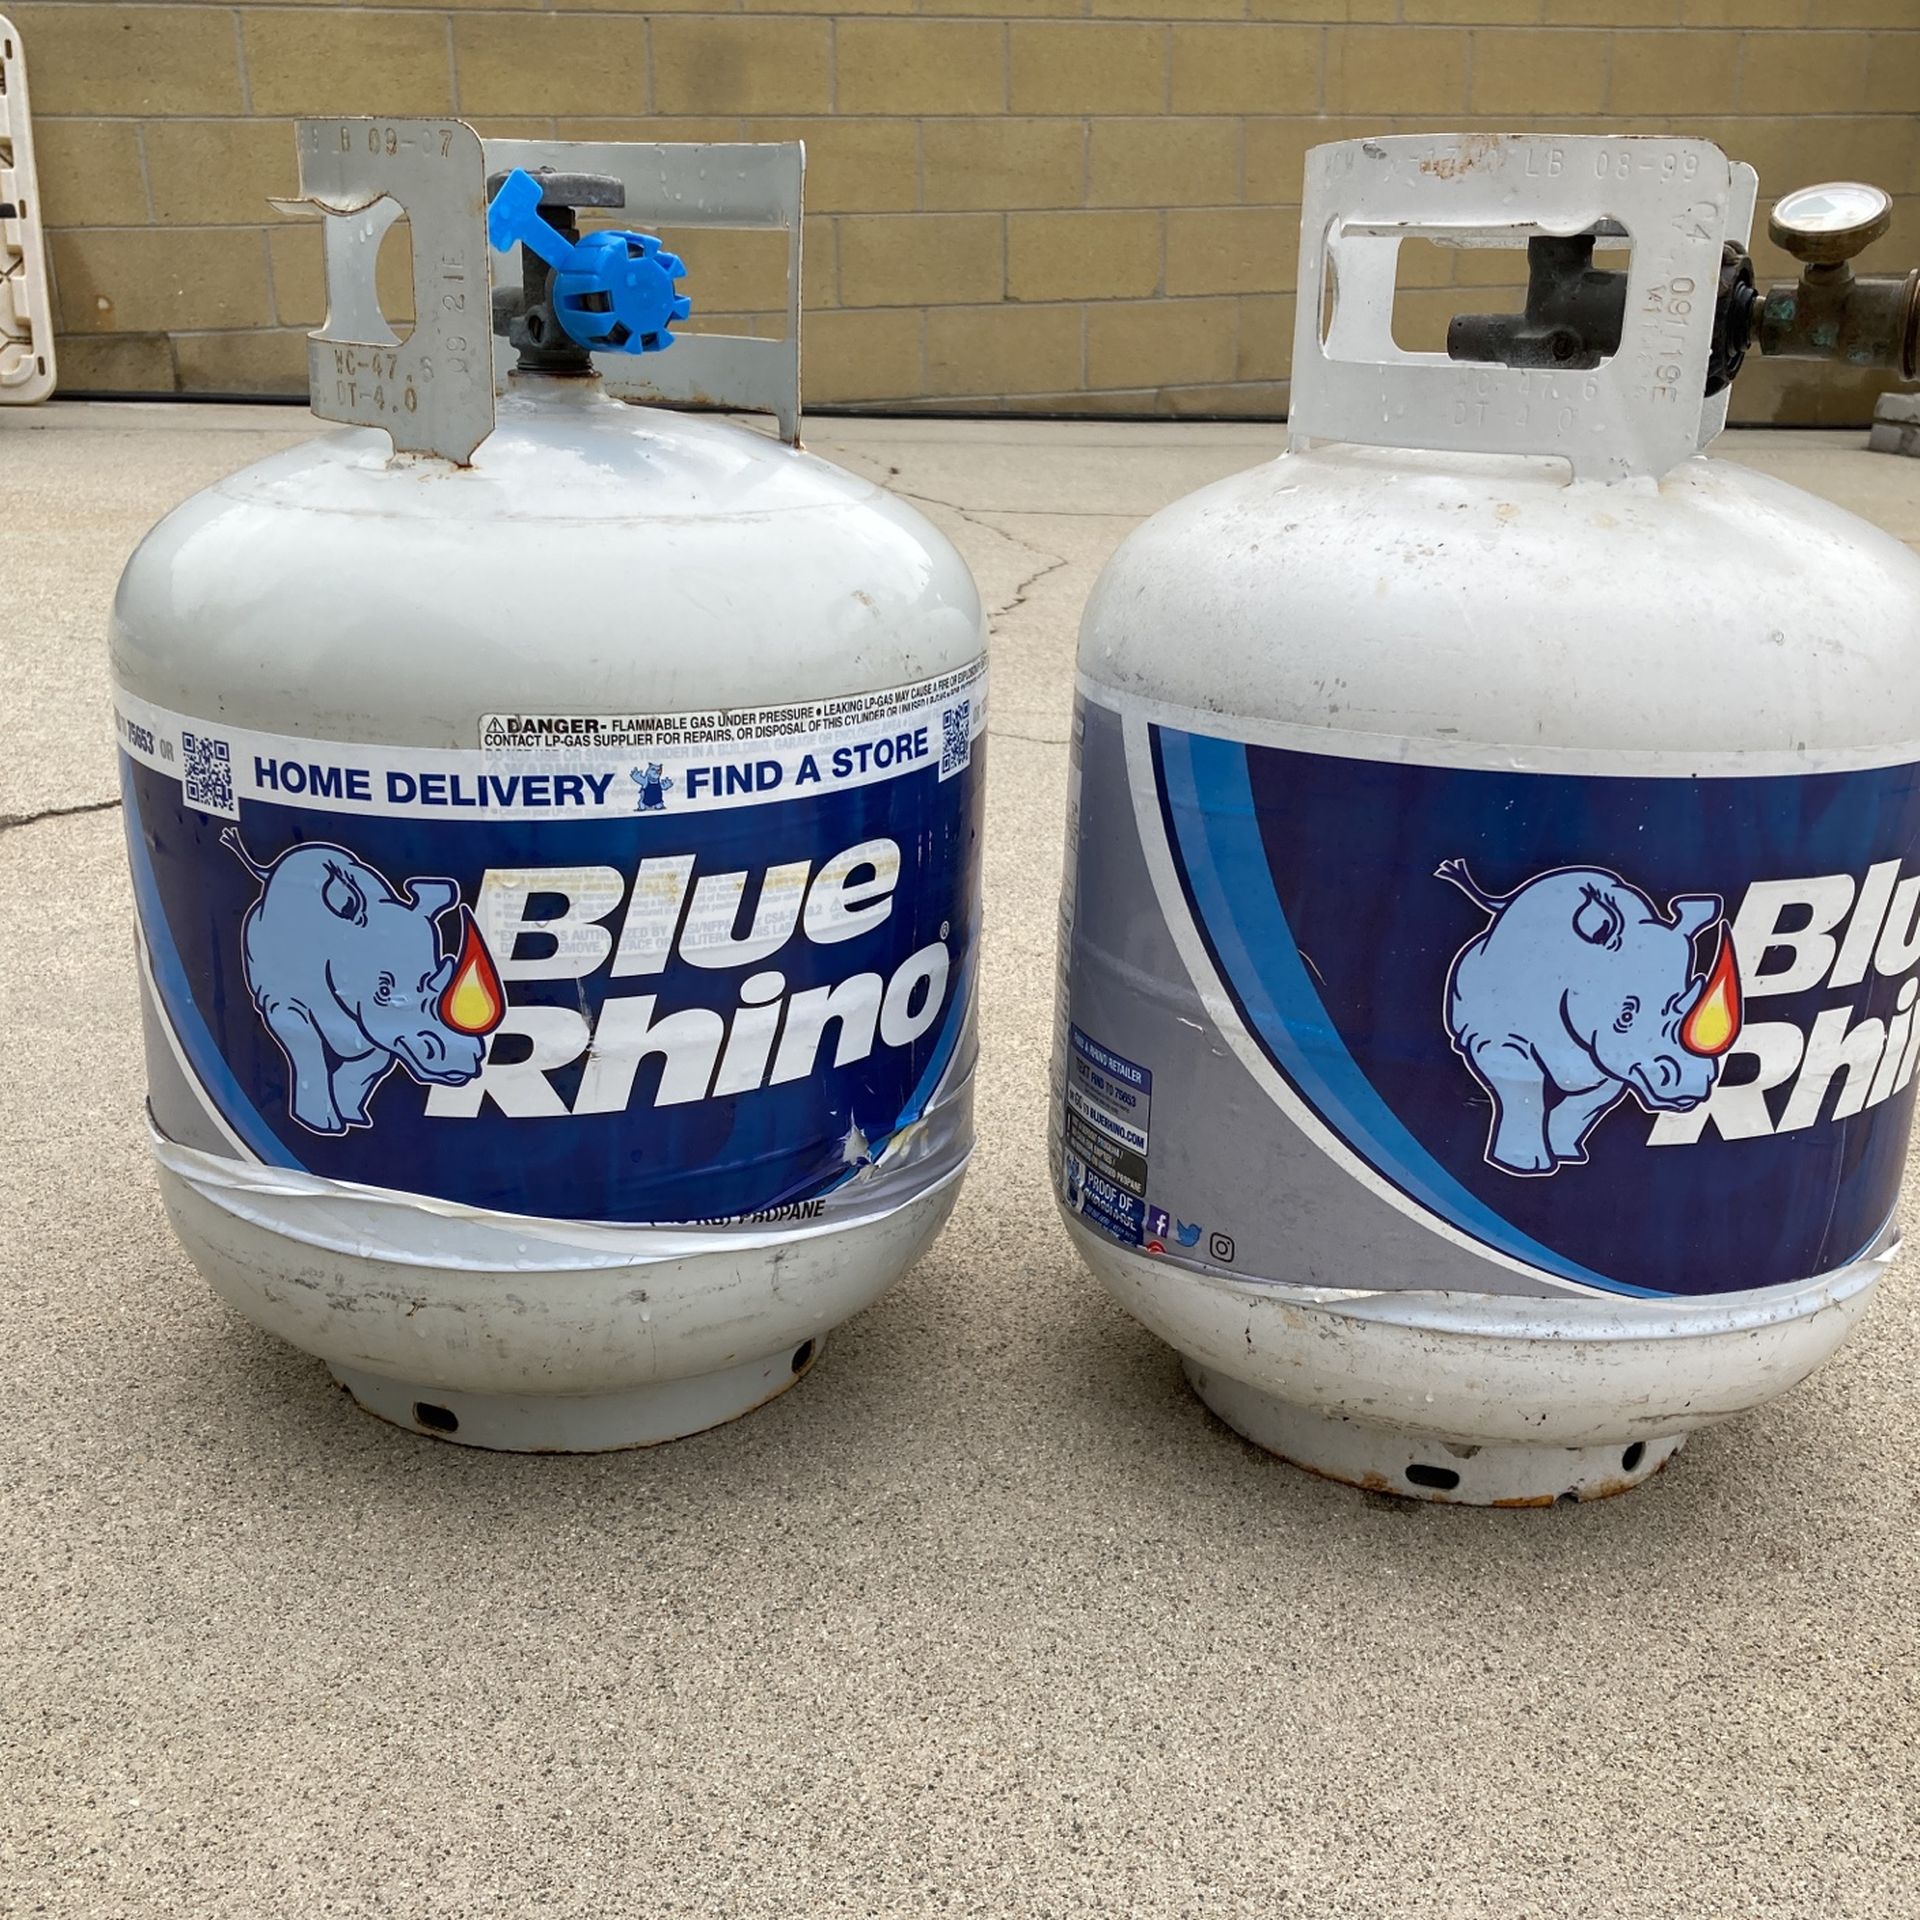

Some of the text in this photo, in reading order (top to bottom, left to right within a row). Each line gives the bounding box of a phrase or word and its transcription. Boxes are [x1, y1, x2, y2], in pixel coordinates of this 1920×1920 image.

[1526, 148, 1564, 177] LB
[484, 734, 541, 746] CONTACT
[545, 734, 591, 747] LP-GAS
[594, 733, 652, 746] SUPPLIER
[656, 732, 680, 745] FOR
[684, 729, 734, 744] REPAIRS,
[737, 727, 753, 740] OR
[755, 721, 806, 739] DISPOSAL
[808, 719, 822, 732] OF
[823, 716, 843, 730] THIS
[844, 709, 885, 727] CYLINDER
[612, 717, 687, 732] FLAMMABLE
[690, 715, 715, 729] GAS
[718, 711, 756, 727] UNDER
[759, 706, 814, 723] PRESSURE
[824, 698, 863, 717] LEAKING
[864, 692, 894, 710] LP-GAS
[895, 688, 909, 705] MAY
[911, 685, 932, 701] CAUSE
[254, 757, 373, 802] HOME
[386, 772, 616, 808] DELIVERY
[687, 759, 783, 800] FIND
[796, 755, 822, 785] A
[832, 727, 930, 778] STORE
[475, 837, 901, 981] Blue
[423, 941, 950, 1119] Rhino
[1109, 1057, 1142, 1085] RETAILER
[1646, 977, 1920, 1146] Rhi
[1087, 1171, 1134, 1212] PROOF OF
